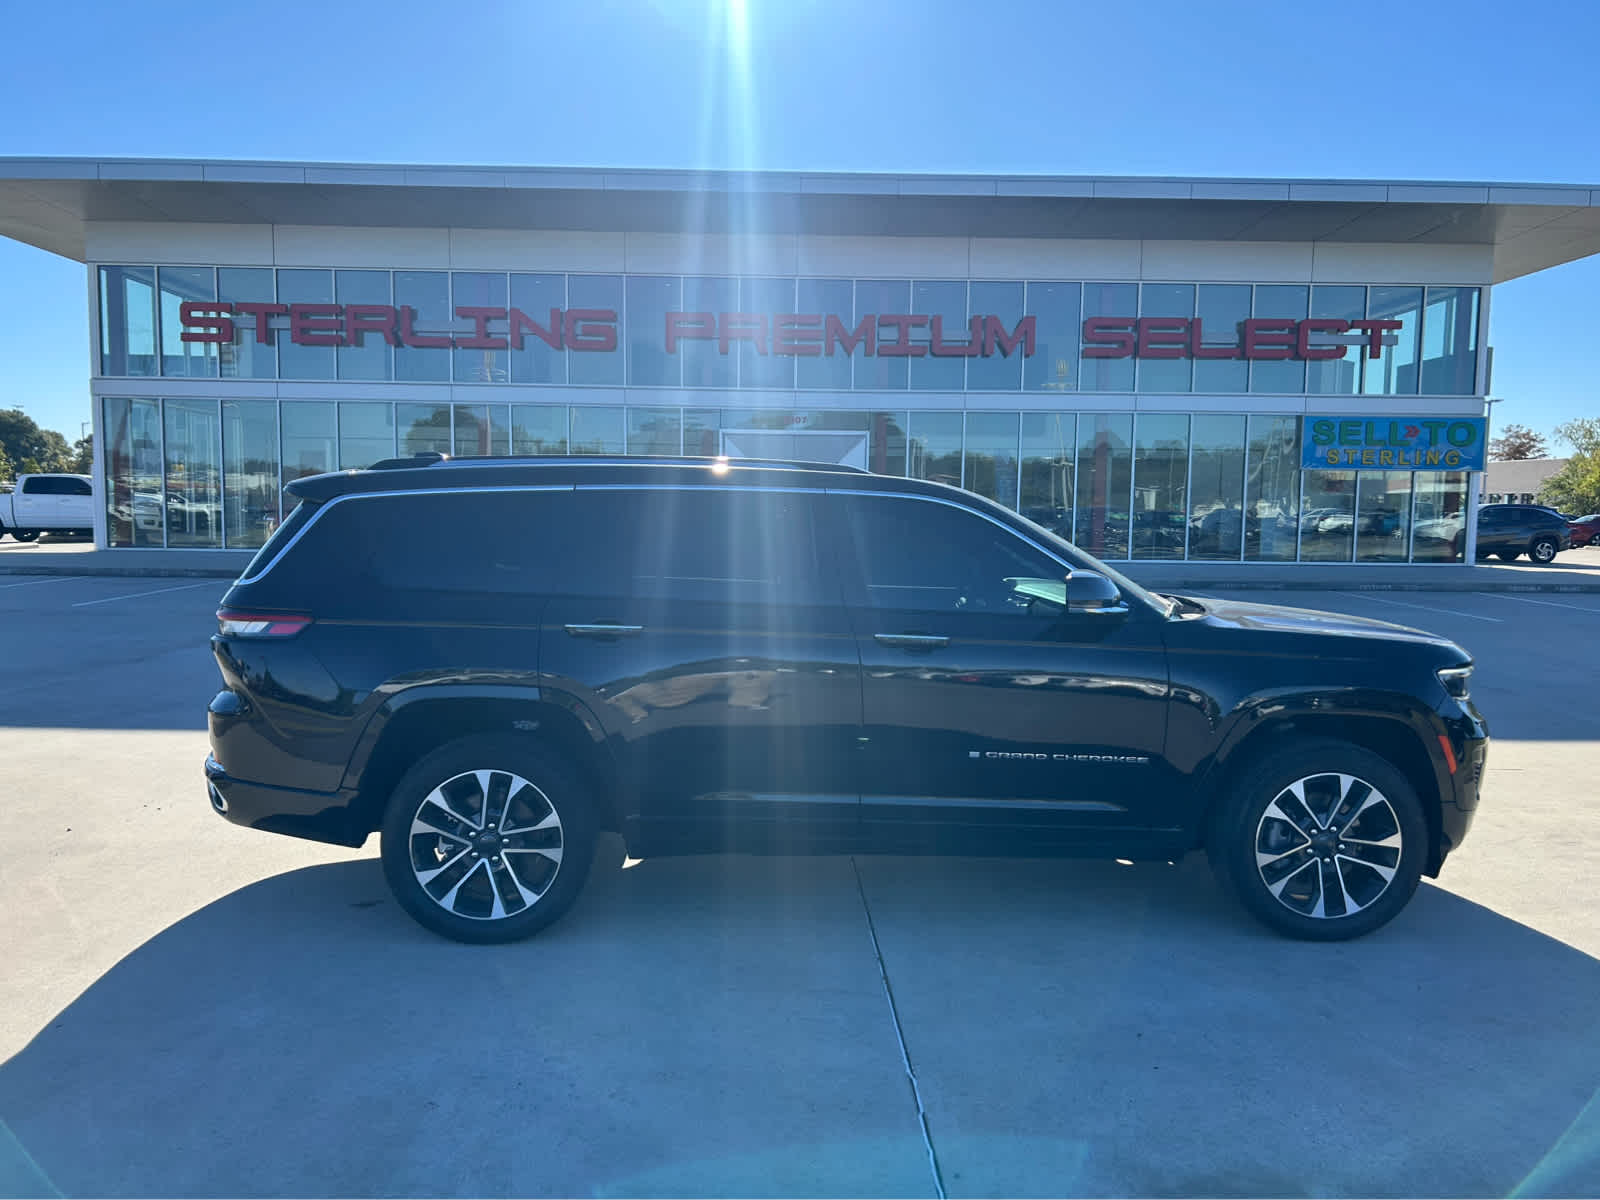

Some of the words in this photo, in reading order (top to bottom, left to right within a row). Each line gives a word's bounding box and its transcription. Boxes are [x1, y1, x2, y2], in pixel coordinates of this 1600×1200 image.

[179, 302, 618, 352] STERLING
[665, 311, 1037, 358] PREMIUM
[1081, 316, 1403, 360] SELECT
[1312, 419, 1412, 447] SELL
[1421, 420, 1477, 447] TO
[1326, 448, 1461, 466] STERLING
[985, 750, 1048, 761] GRAND
[1052, 753, 1150, 764] CHEROKEE
